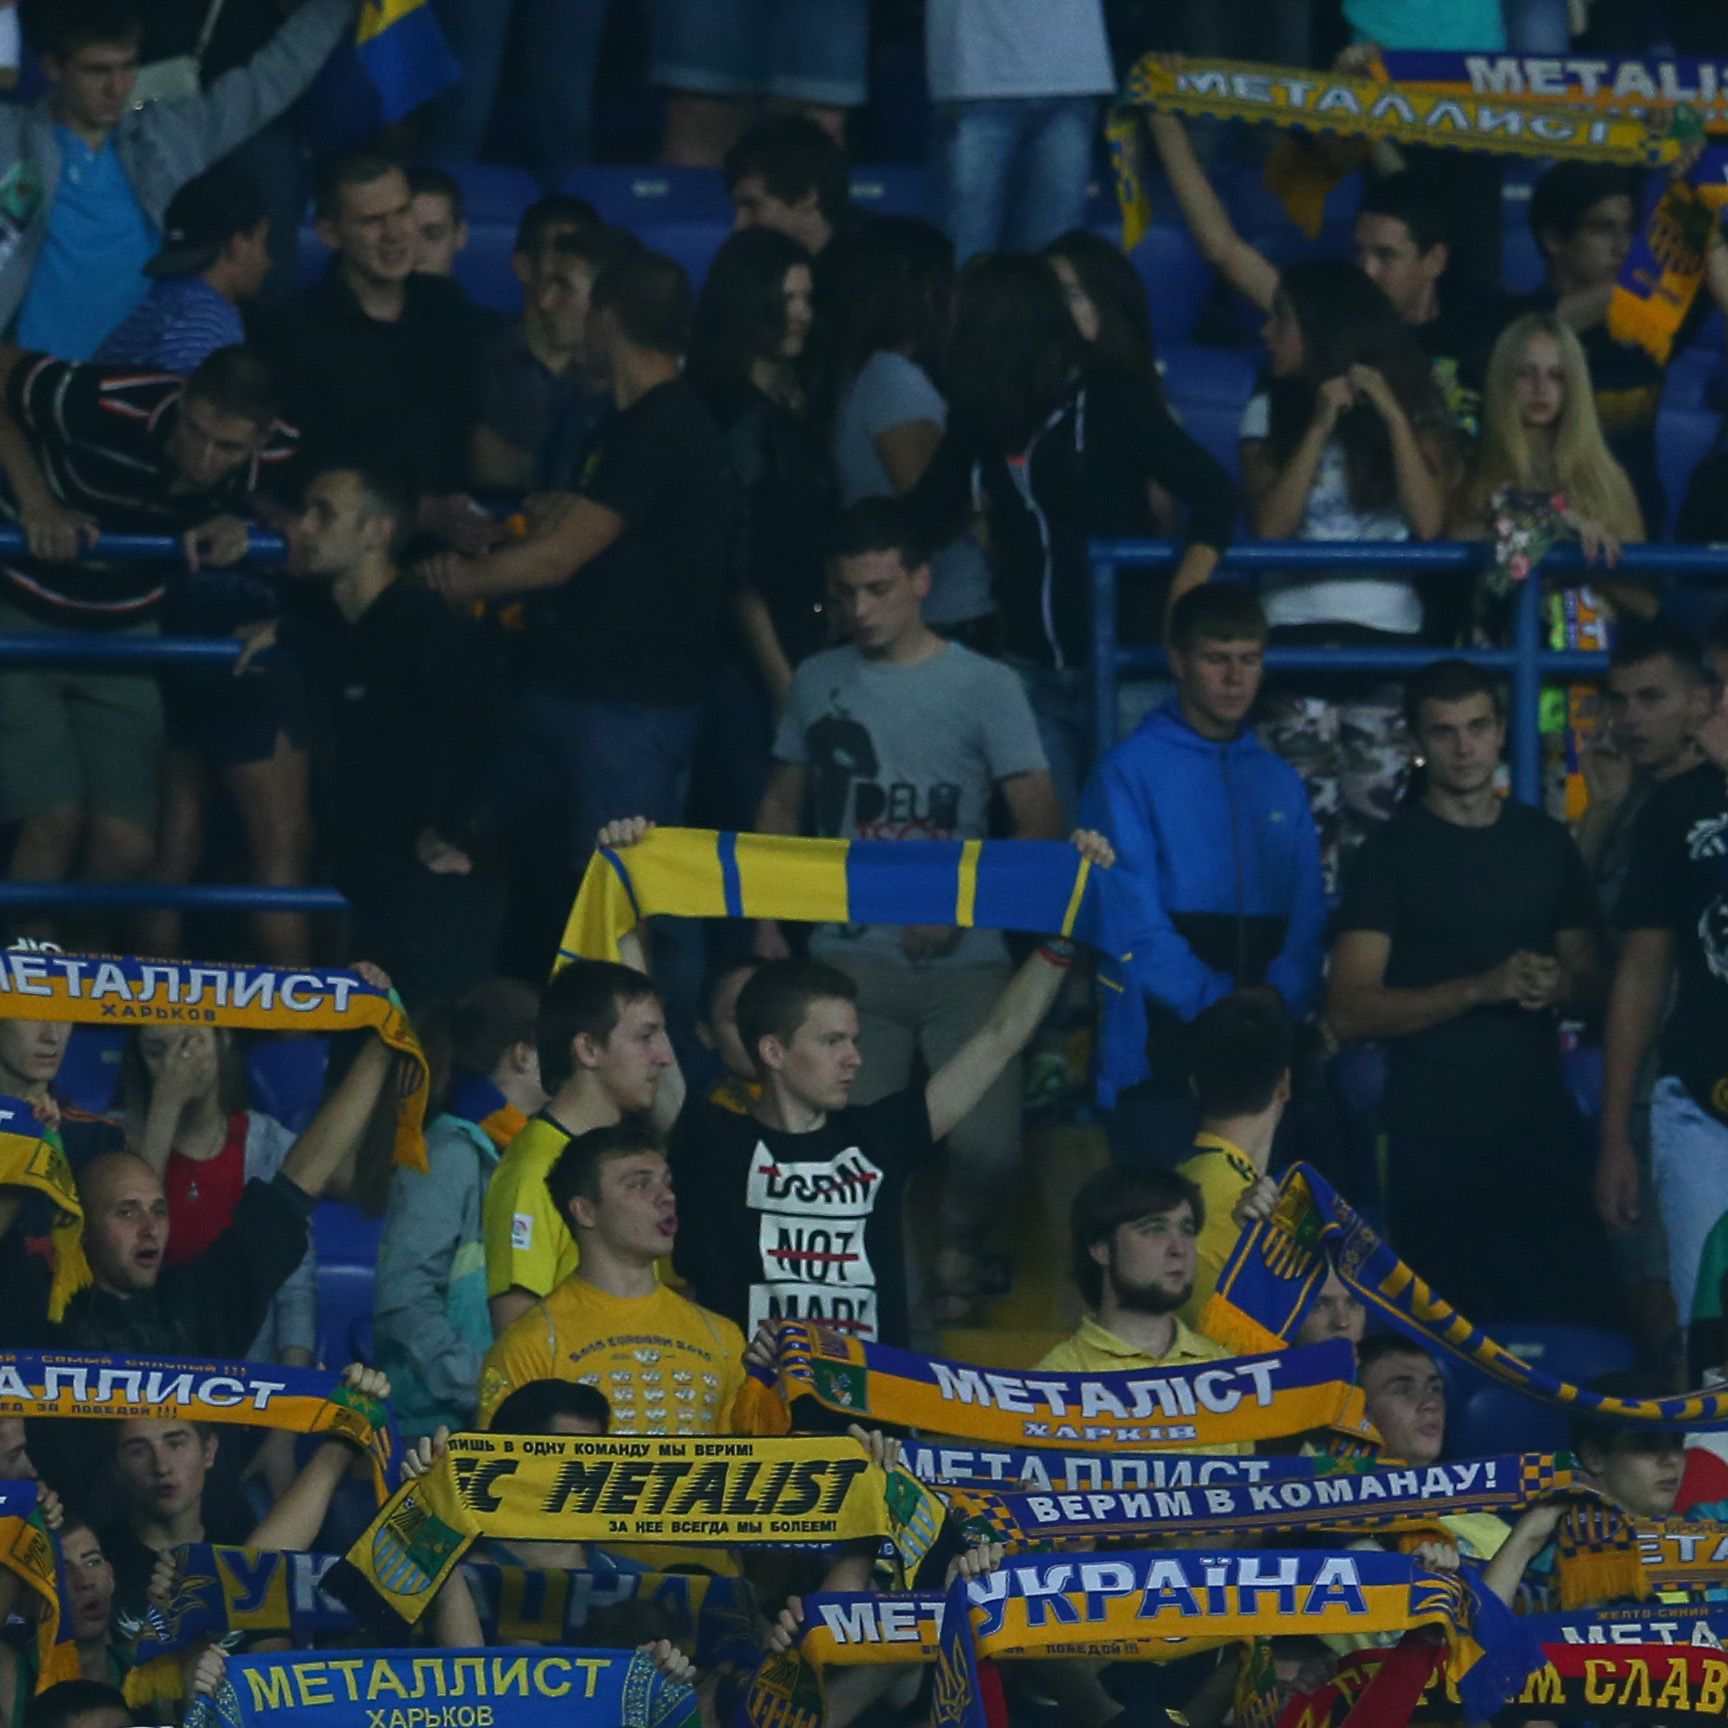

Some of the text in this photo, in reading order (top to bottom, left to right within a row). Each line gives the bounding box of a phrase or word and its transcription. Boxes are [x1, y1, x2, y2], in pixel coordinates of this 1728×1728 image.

[101, 1003, 217, 1022] ХАРЬКОВ
[776, 1229, 855, 1283] NOT
[928, 1357, 1284, 1420] МЕТАЛІСТ
[522, 1440, 567, 1457] ОДНУ
[573, 1442, 650, 1459] КОМАНДУ
[658, 1444, 684, 1457] МЫ
[694, 1444, 753, 1458] ВЕРИМ!
[1023, 1419, 1199, 1443] ХАРКІВ
[540, 1457, 869, 1515] METALIST
[1026, 1461, 1499, 1525] ВЕРИМ В КОМАНДУ!
[608, 1520, 837, 1537] ЗА НЕЕ ВСЕГДА МЫ БОЛЕЕМ!
[968, 1556, 1369, 1638] УКРАЇНА
[242, 1657, 612, 1712] МЕТАЛЛИСТ
